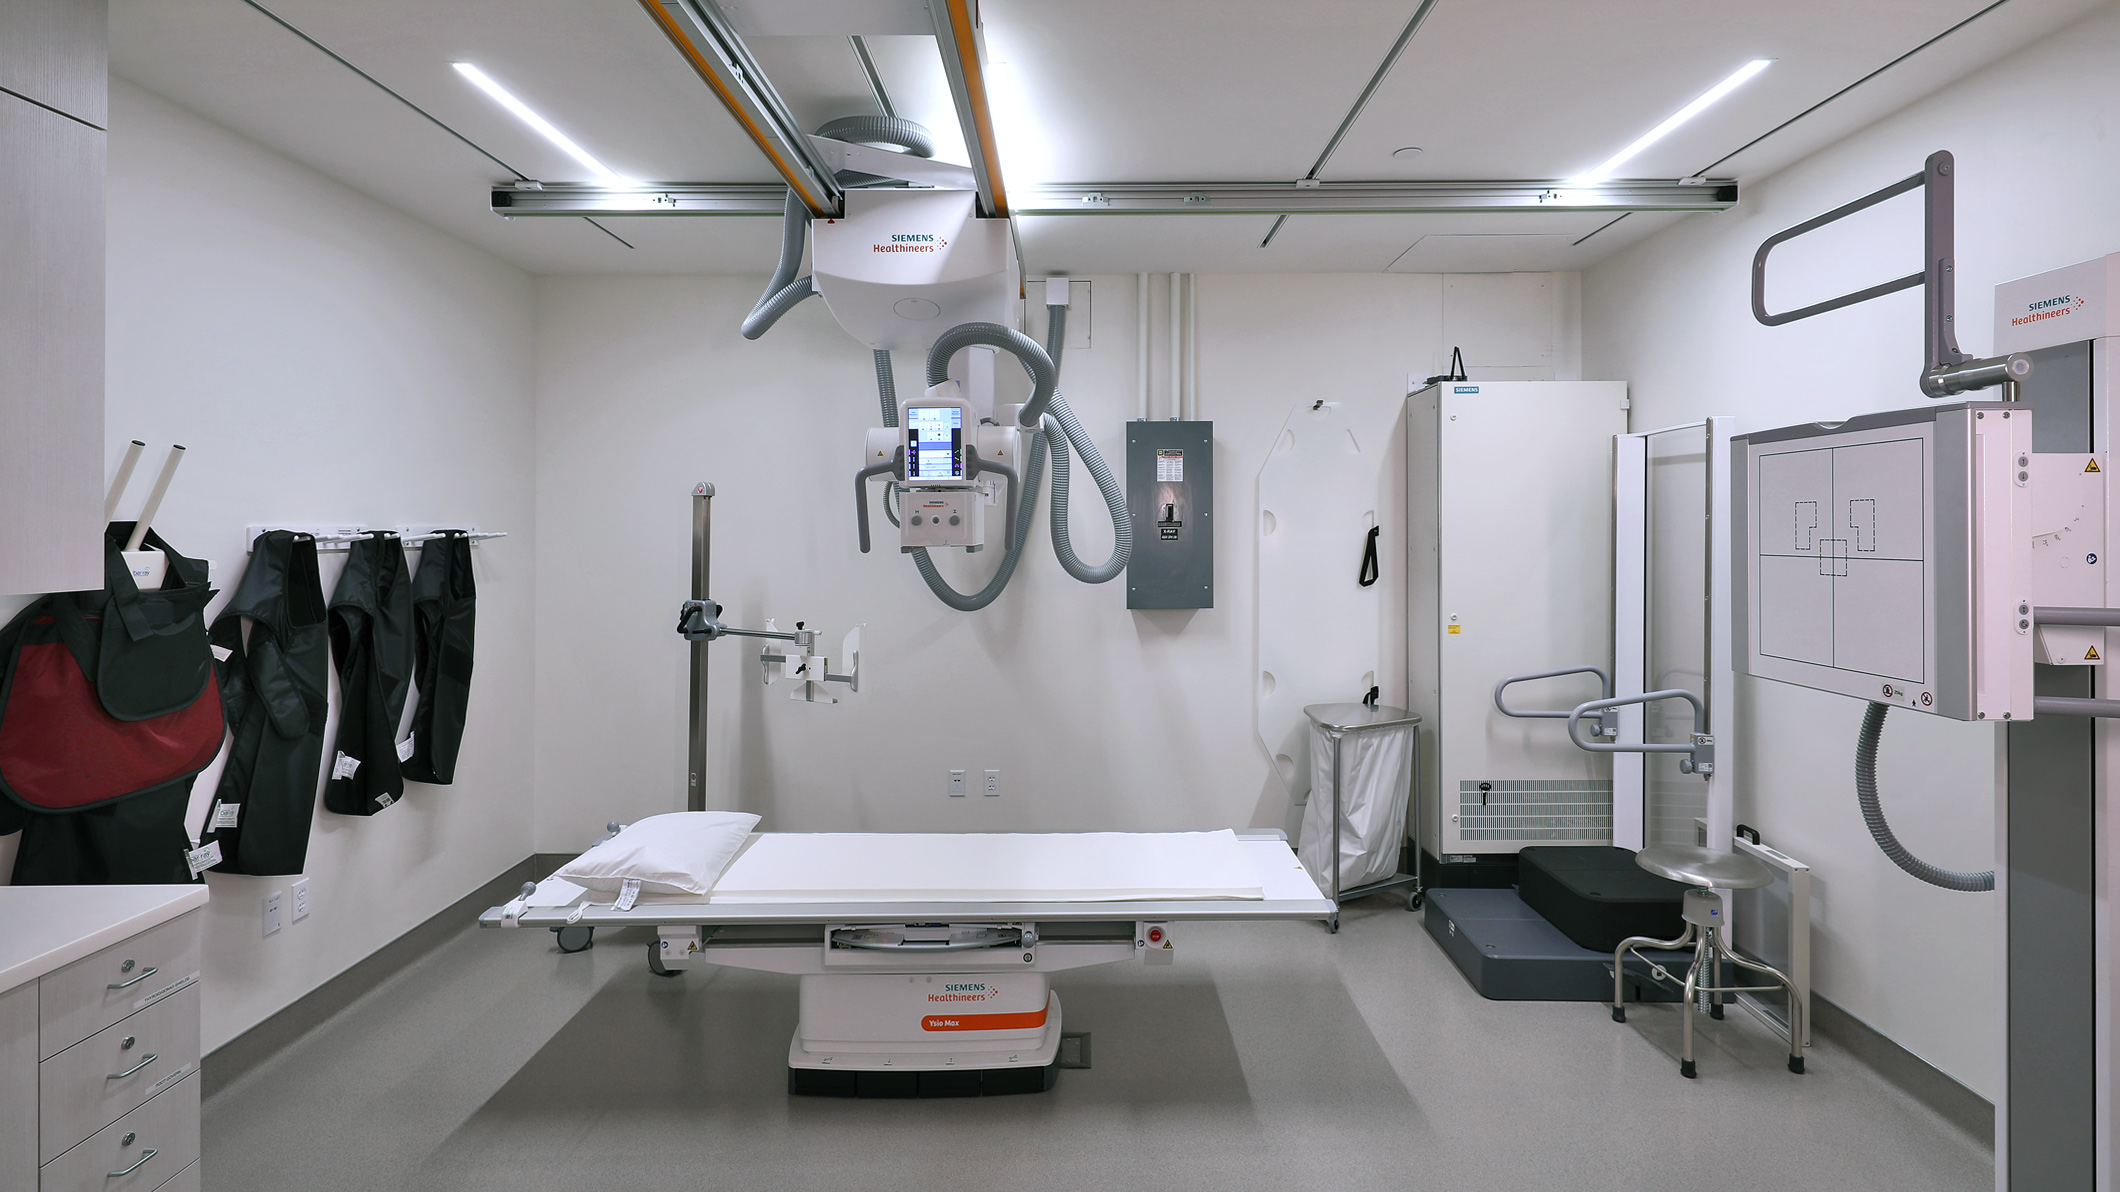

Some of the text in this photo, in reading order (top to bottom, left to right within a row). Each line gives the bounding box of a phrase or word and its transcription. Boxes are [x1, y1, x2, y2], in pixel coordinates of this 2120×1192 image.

[891, 234, 934, 242] SIEMENS
[873, 243, 934, 253] Healthineers
[2028, 294, 2071, 312] SIEMENS
[2011, 307, 2071, 327] Healthineers
[945, 983, 986, 992] SIEMENS
[927, 993, 986, 1002] Healthineers
